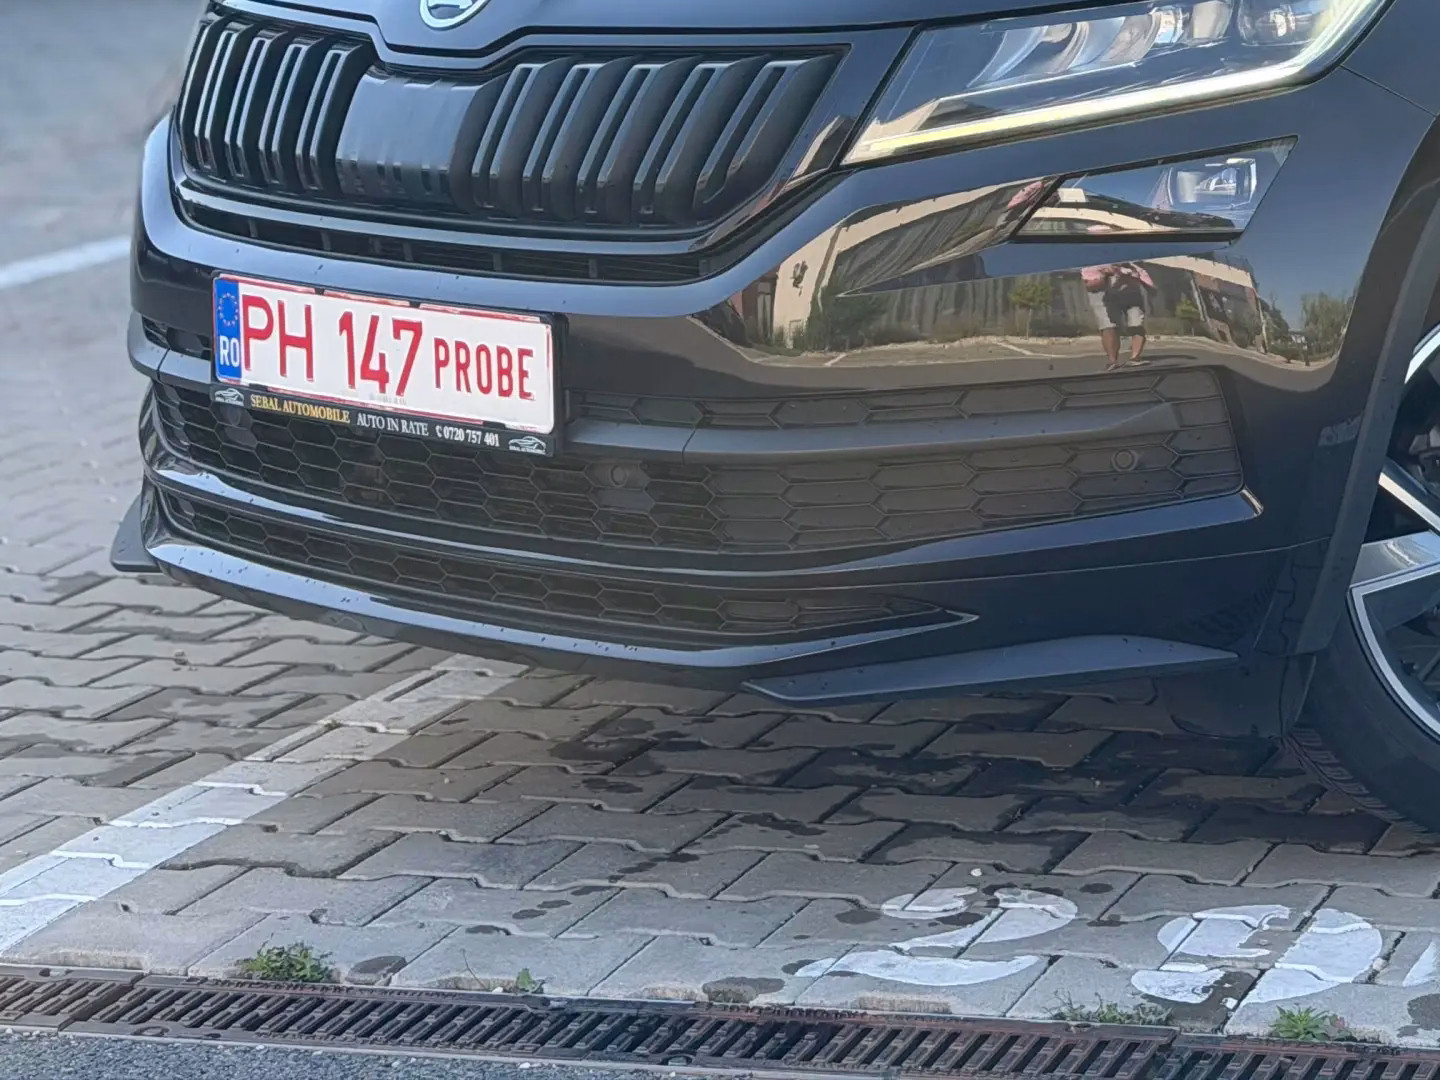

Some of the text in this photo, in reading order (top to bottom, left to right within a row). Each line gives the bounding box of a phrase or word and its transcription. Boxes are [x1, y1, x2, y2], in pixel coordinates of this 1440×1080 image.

[219, 335, 240, 368] RO
[242, 294, 536, 400] PH 147 PROBE
[250, 394, 281, 412] SEBAL
[283, 401, 350, 423] AUTOMOBILE
[356, 412, 385, 429] AUTO
[387, 418, 399, 432] IN
[401, 419, 429, 436] RATE
[444, 427, 465, 442] 0720
[466, 429, 482, 445] 757
